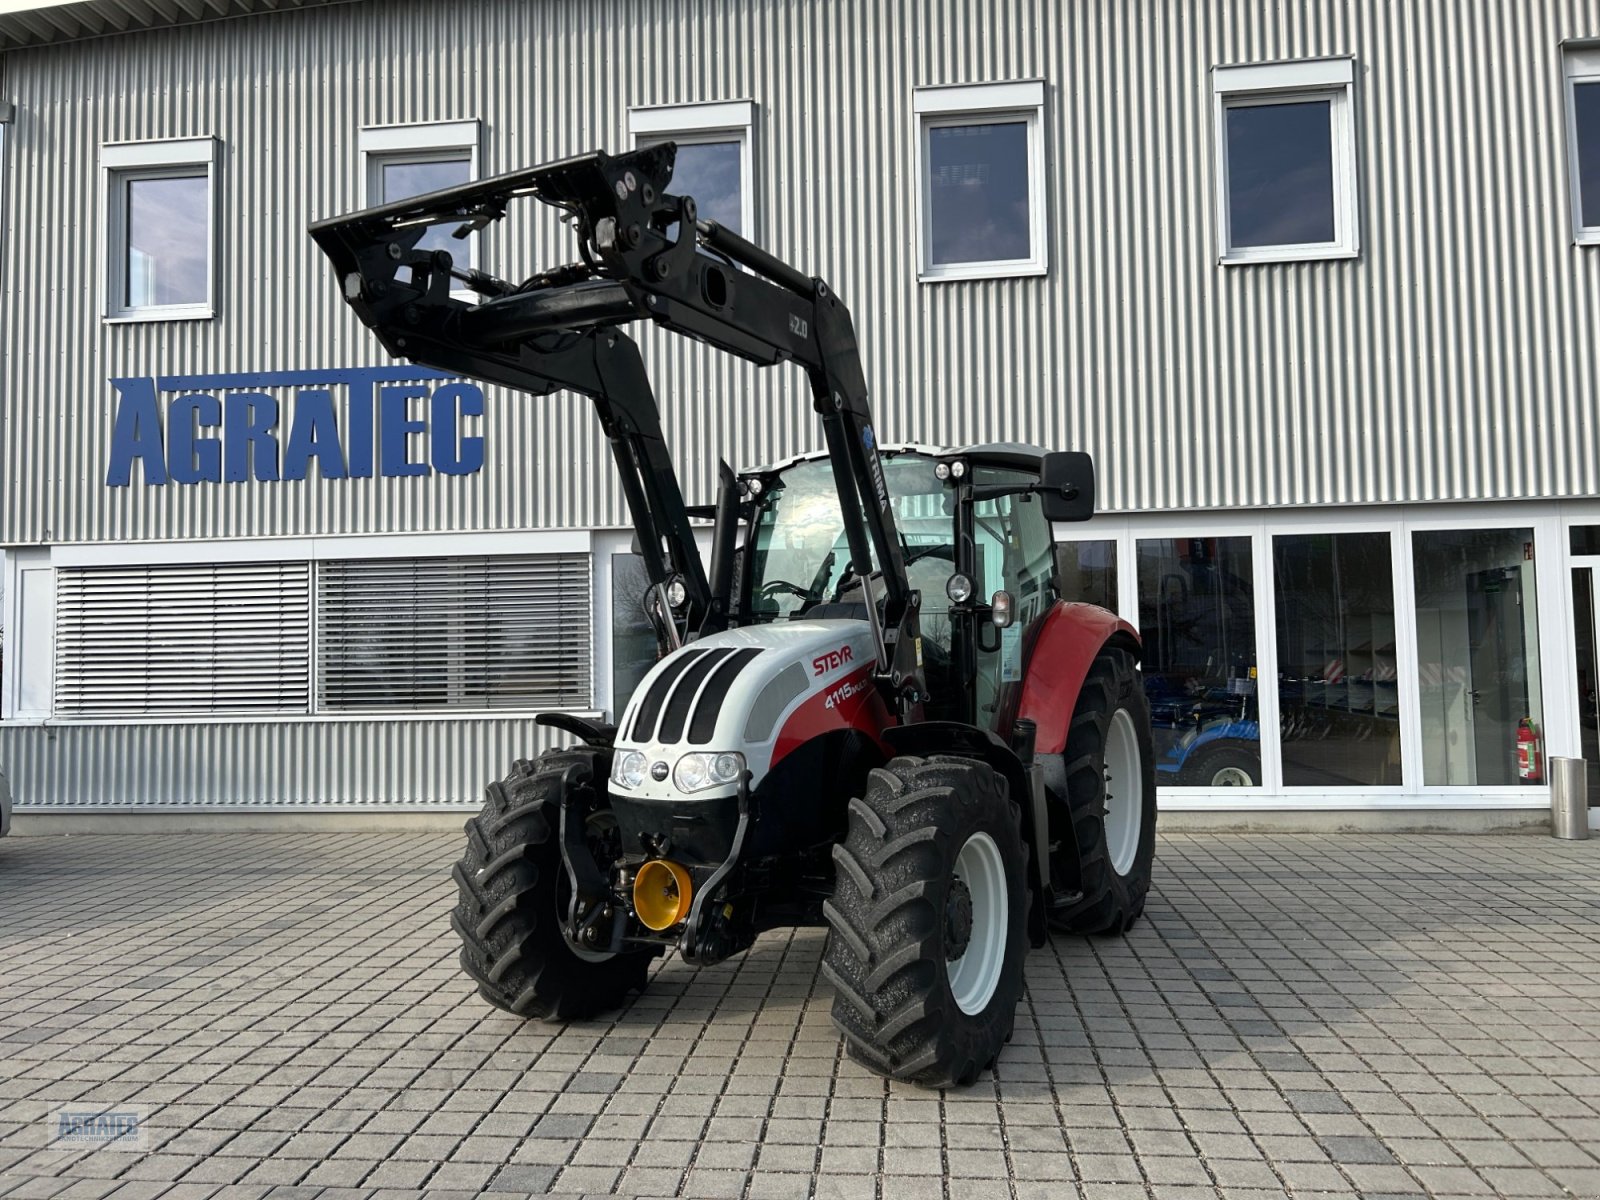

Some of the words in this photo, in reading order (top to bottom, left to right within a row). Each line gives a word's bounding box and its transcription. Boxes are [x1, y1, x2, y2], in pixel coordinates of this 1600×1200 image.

[106, 365, 484, 487] AGRATEC
[869, 448, 888, 515] TRIMA
[812, 645, 854, 677] STEYR
